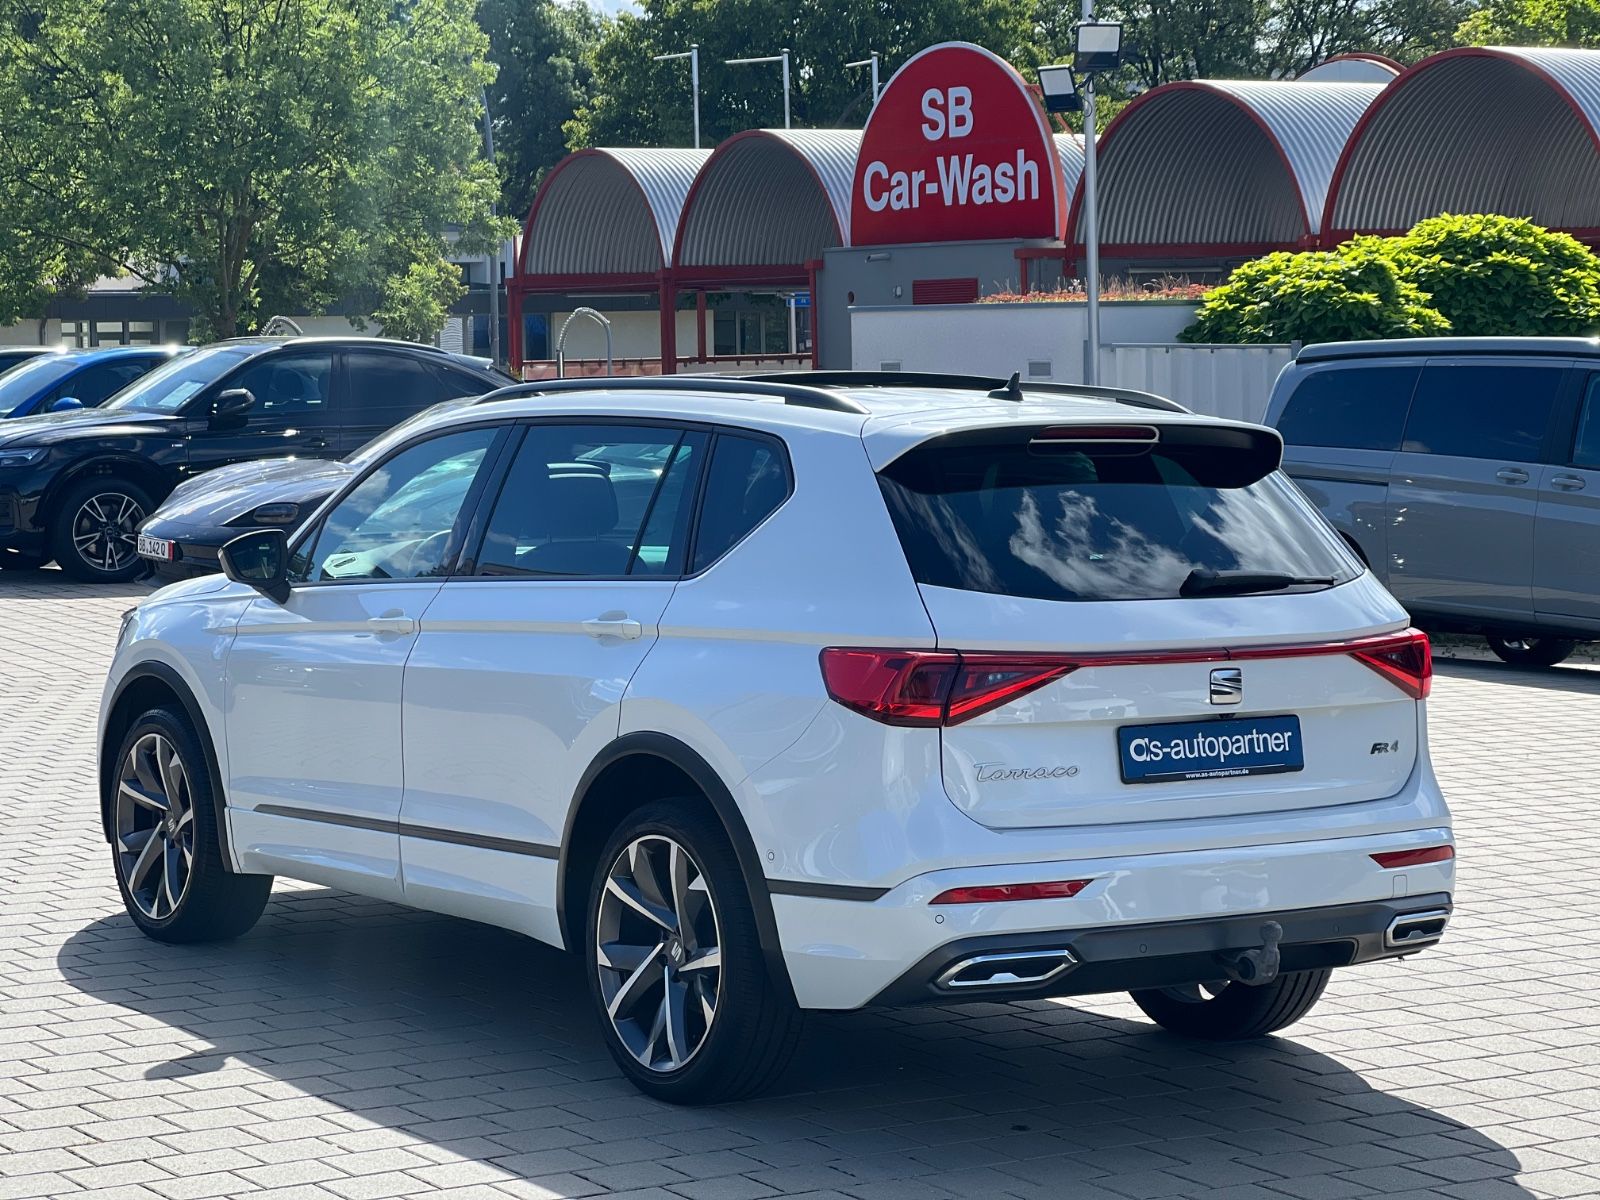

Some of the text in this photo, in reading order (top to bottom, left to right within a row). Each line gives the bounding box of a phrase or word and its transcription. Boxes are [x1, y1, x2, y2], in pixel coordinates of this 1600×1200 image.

[921, 86, 974, 141] SB
[863, 149, 1040, 212] Car-Wash
[1129, 729, 1292, 763] as-autopartner
[973, 762, 1079, 782] Tarraco
[1185, 768, 1249, 779] www.as-autopartner.de
